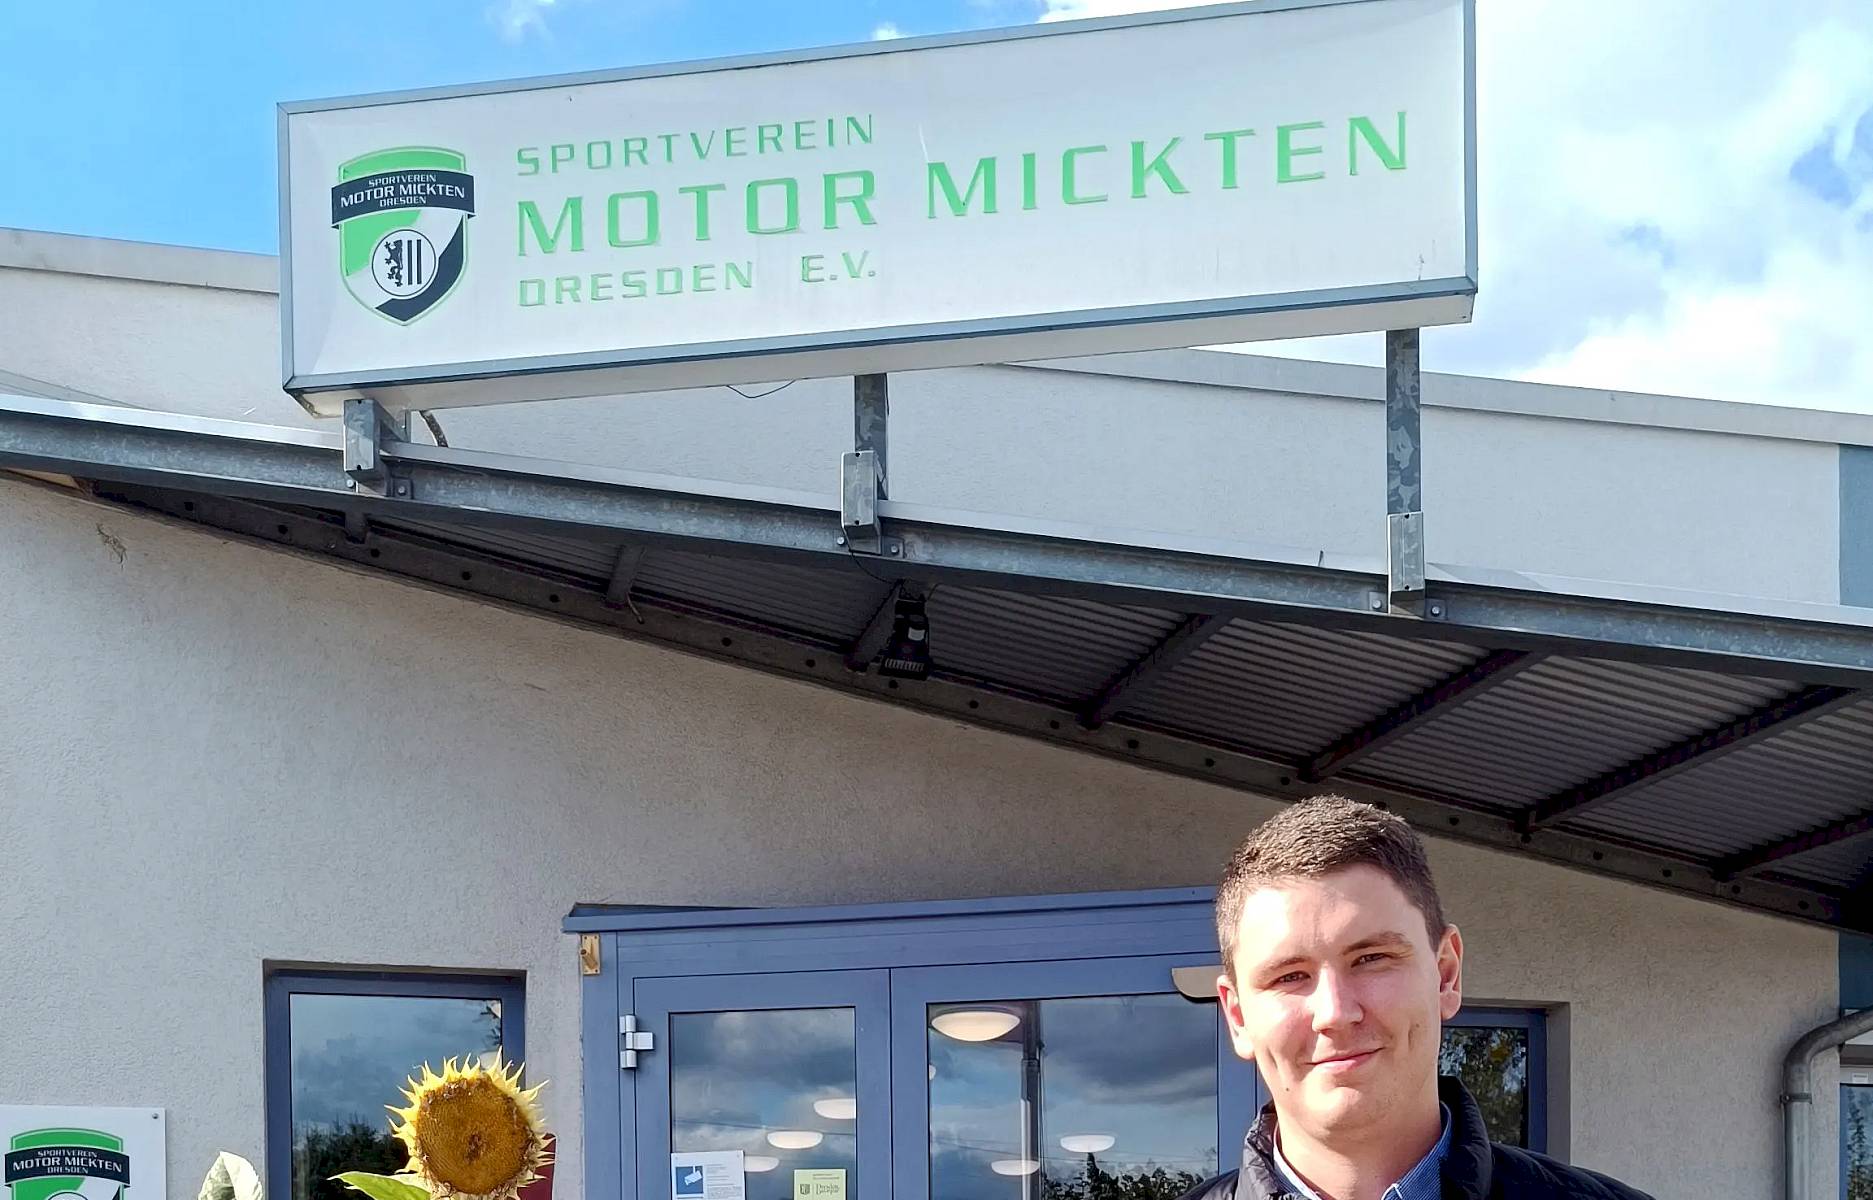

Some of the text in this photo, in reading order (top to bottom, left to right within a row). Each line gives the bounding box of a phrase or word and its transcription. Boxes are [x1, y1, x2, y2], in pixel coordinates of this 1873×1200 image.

[516, 113, 873, 176] SPORTVEREIN
[368, 174, 437, 187] SPORTVEREIN
[517, 111, 1408, 256] MOTOR MICKTEN
[340, 183, 465, 208] MOTOR MICKTEN
[379, 196, 427, 207] DRESDEN
[519, 250, 877, 308] DRESDEN E.V.
[37, 1149, 98, 1158] SPORTVEREIN
[12, 1156, 122, 1173] MOTOR MICKTEN
[47, 1166, 89, 1174] DRESDEN
